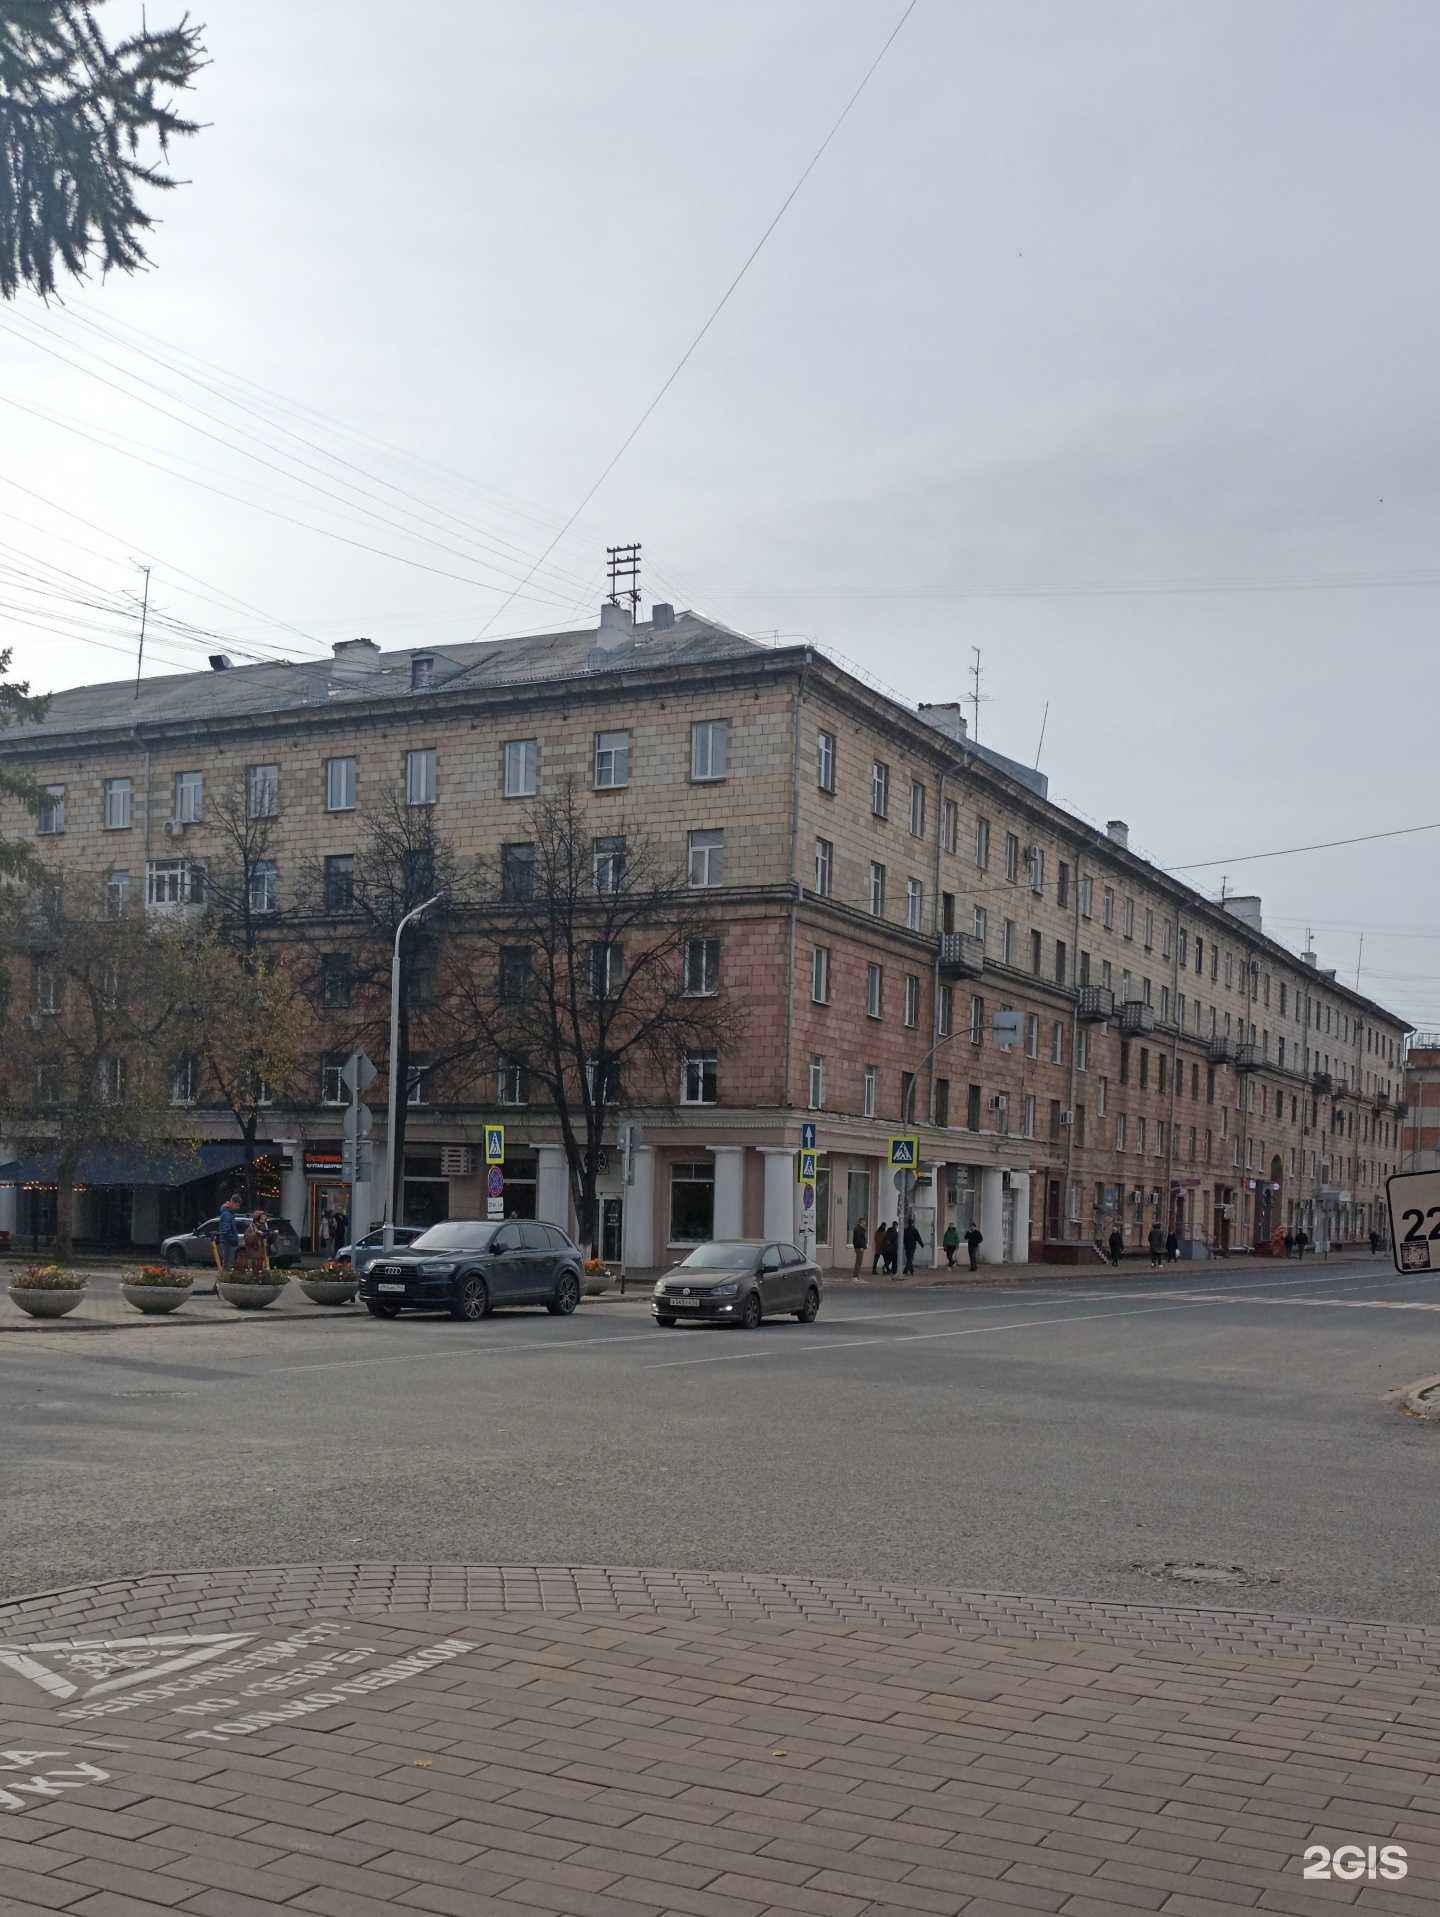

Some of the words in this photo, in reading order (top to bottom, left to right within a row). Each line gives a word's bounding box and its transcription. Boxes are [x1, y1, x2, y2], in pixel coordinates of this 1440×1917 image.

[170, 1698, 240, 1716] ПО
[184, 1693, 347, 1741] ТОЛЬКО
[331, 1639, 480, 1695] ПЕШКОМ
